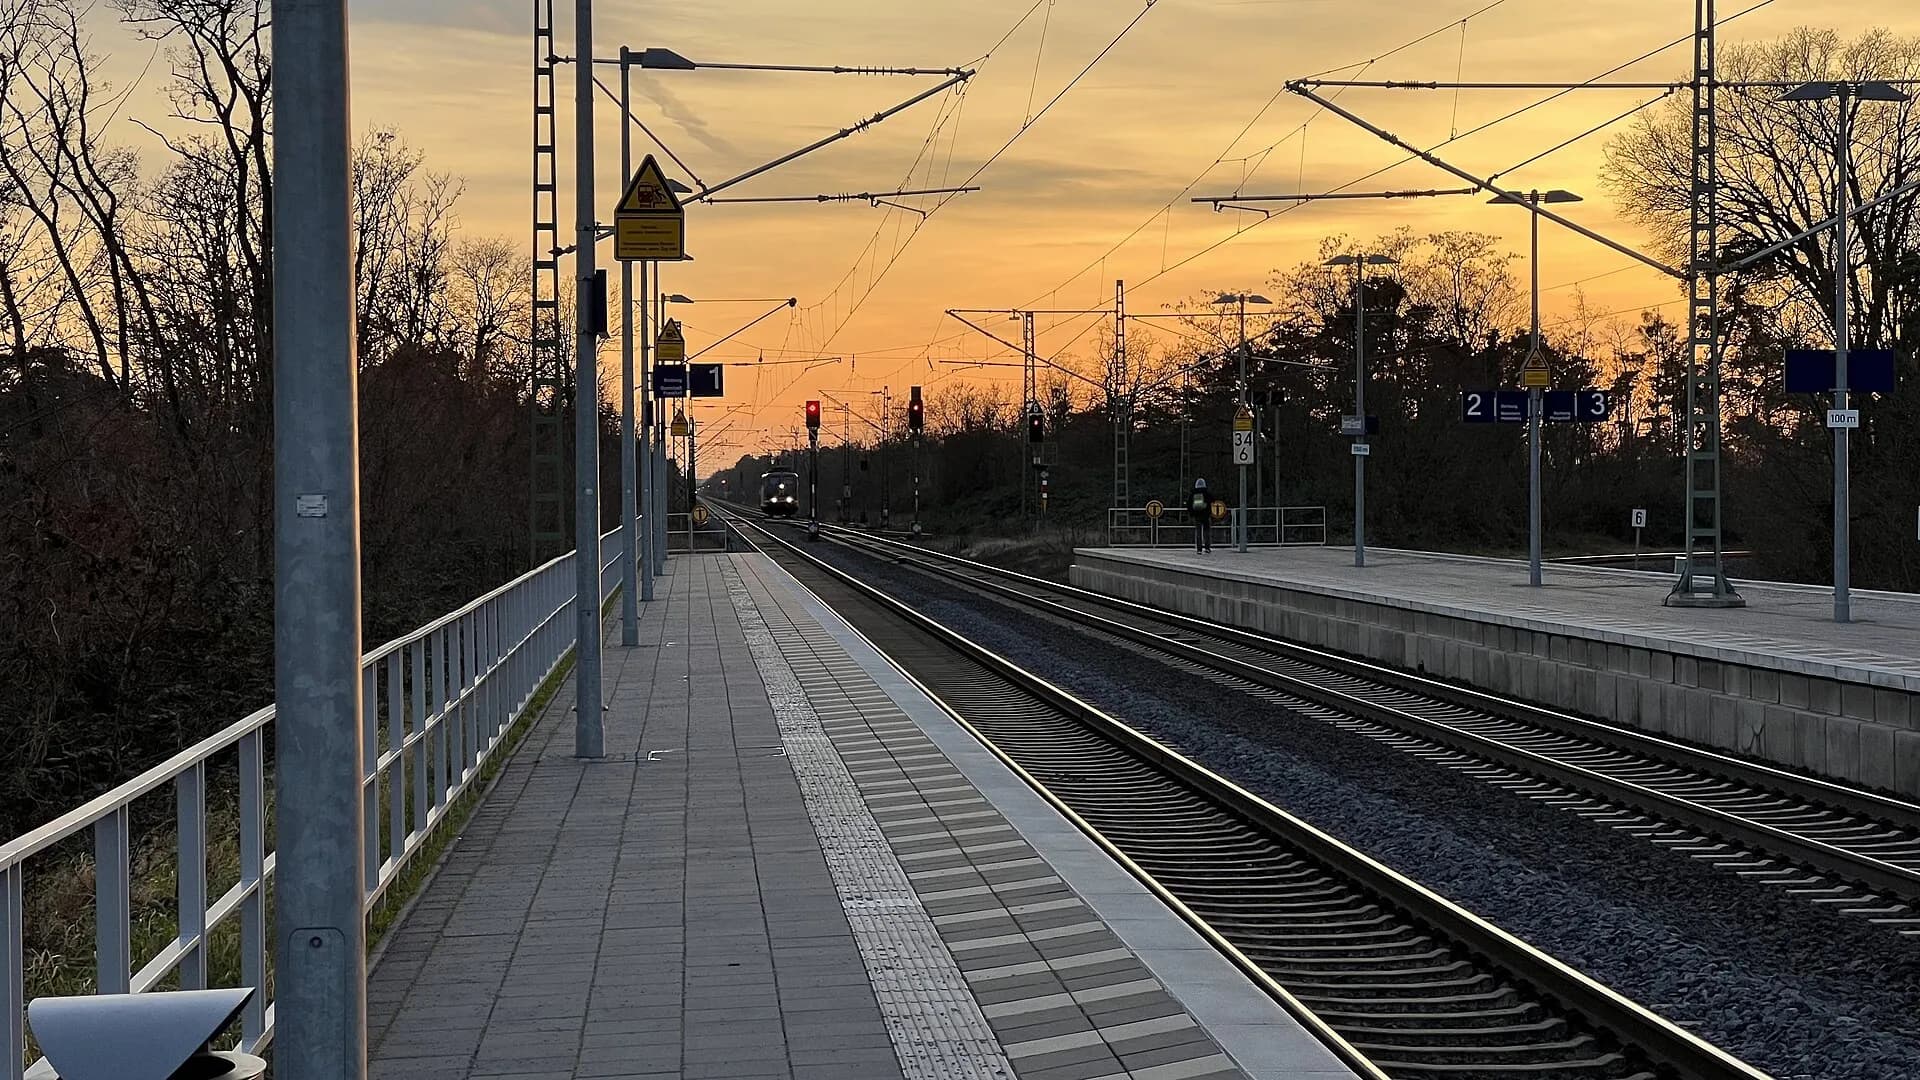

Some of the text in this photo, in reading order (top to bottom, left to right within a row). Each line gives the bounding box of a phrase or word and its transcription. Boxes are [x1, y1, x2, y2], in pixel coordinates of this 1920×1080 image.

[709, 366, 719, 390] 1
[1467, 394, 1482, 415] 2
[1591, 393, 1605, 415] 3
[1831, 414, 1846, 423] 100
[1235, 432, 1252, 446] 34
[1240, 447, 1249, 461] 6
[1635, 511, 1643, 525] 6
